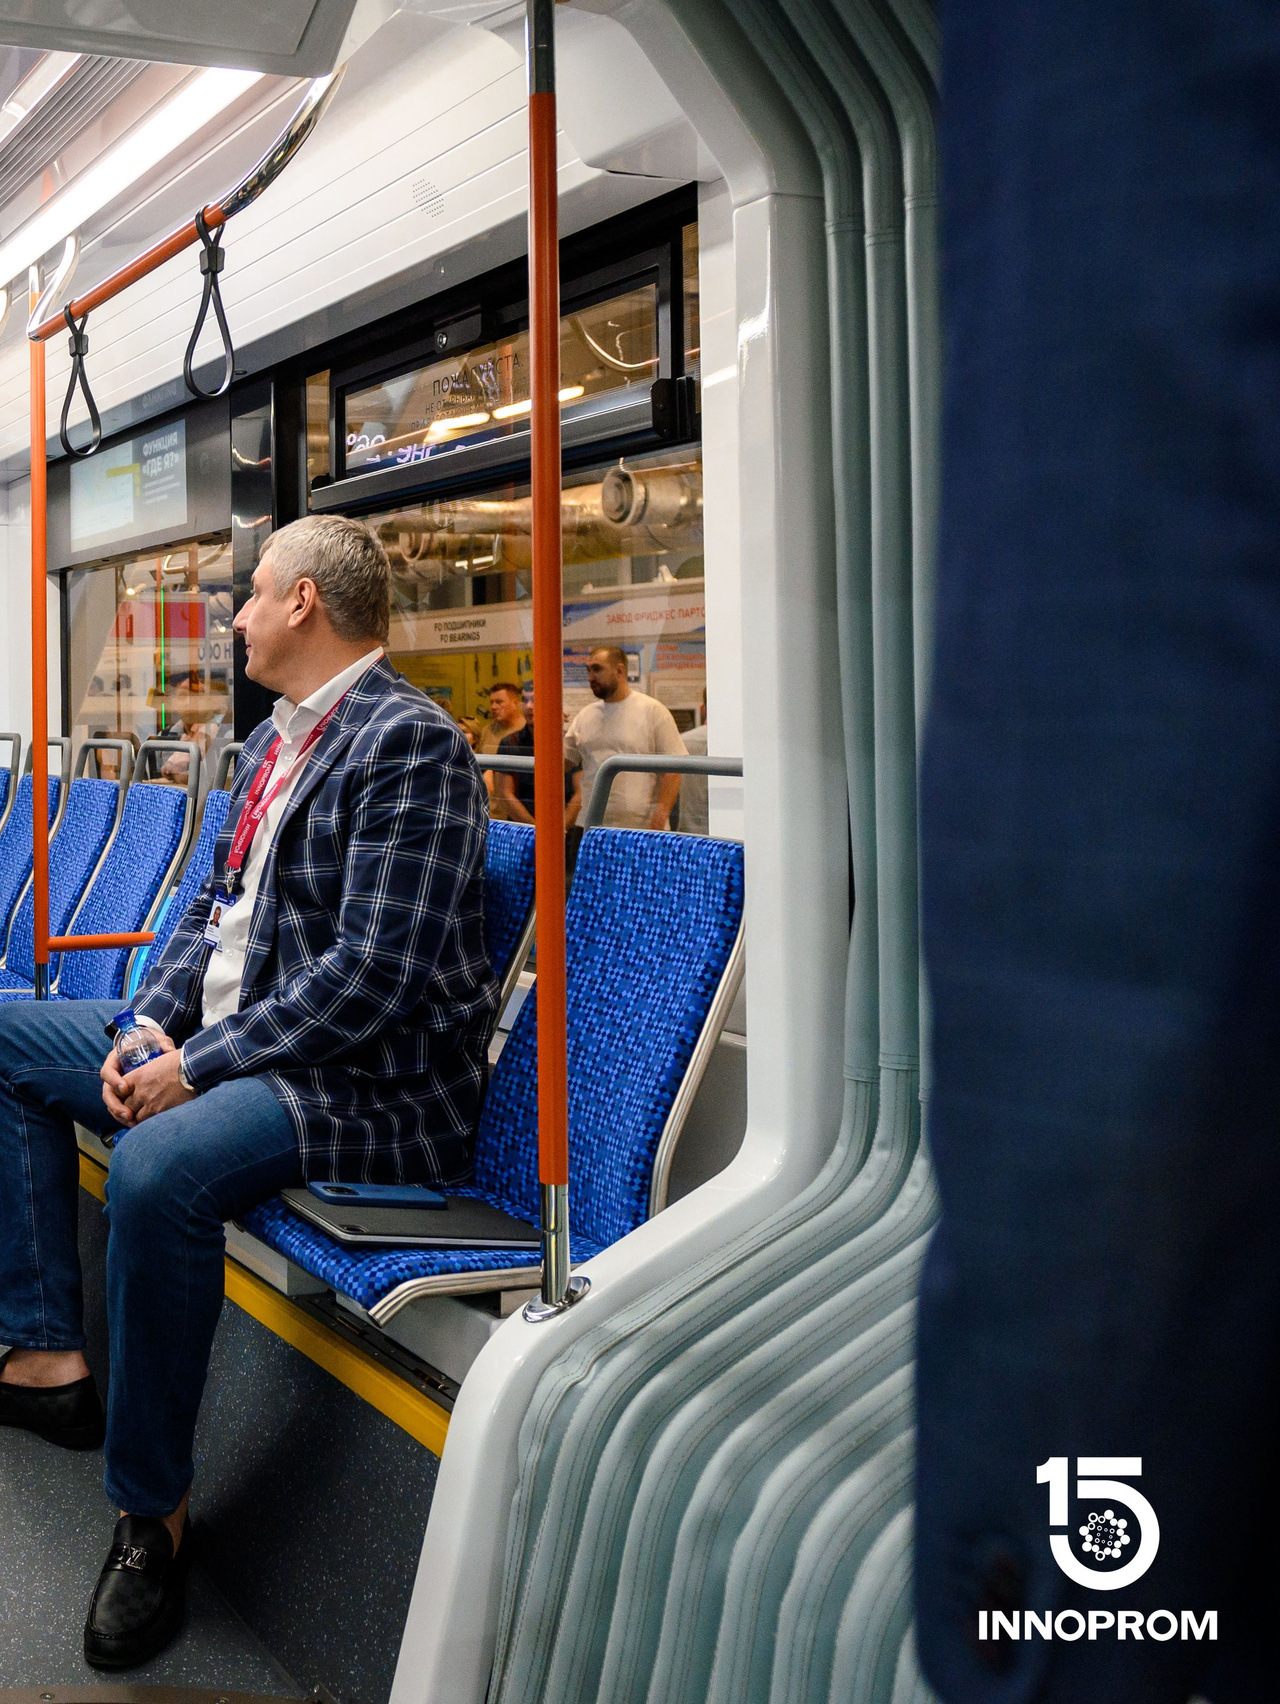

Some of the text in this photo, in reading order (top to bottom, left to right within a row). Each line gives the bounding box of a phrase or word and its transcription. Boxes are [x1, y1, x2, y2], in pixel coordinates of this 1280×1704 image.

[142, 431, 178, 457] ФУНКЦИЯ
[606, 612, 633, 625] ЗАВОД
[450, 631, 481, 642] BEARINGS
[255, 764, 272, 796] INNOPROM
